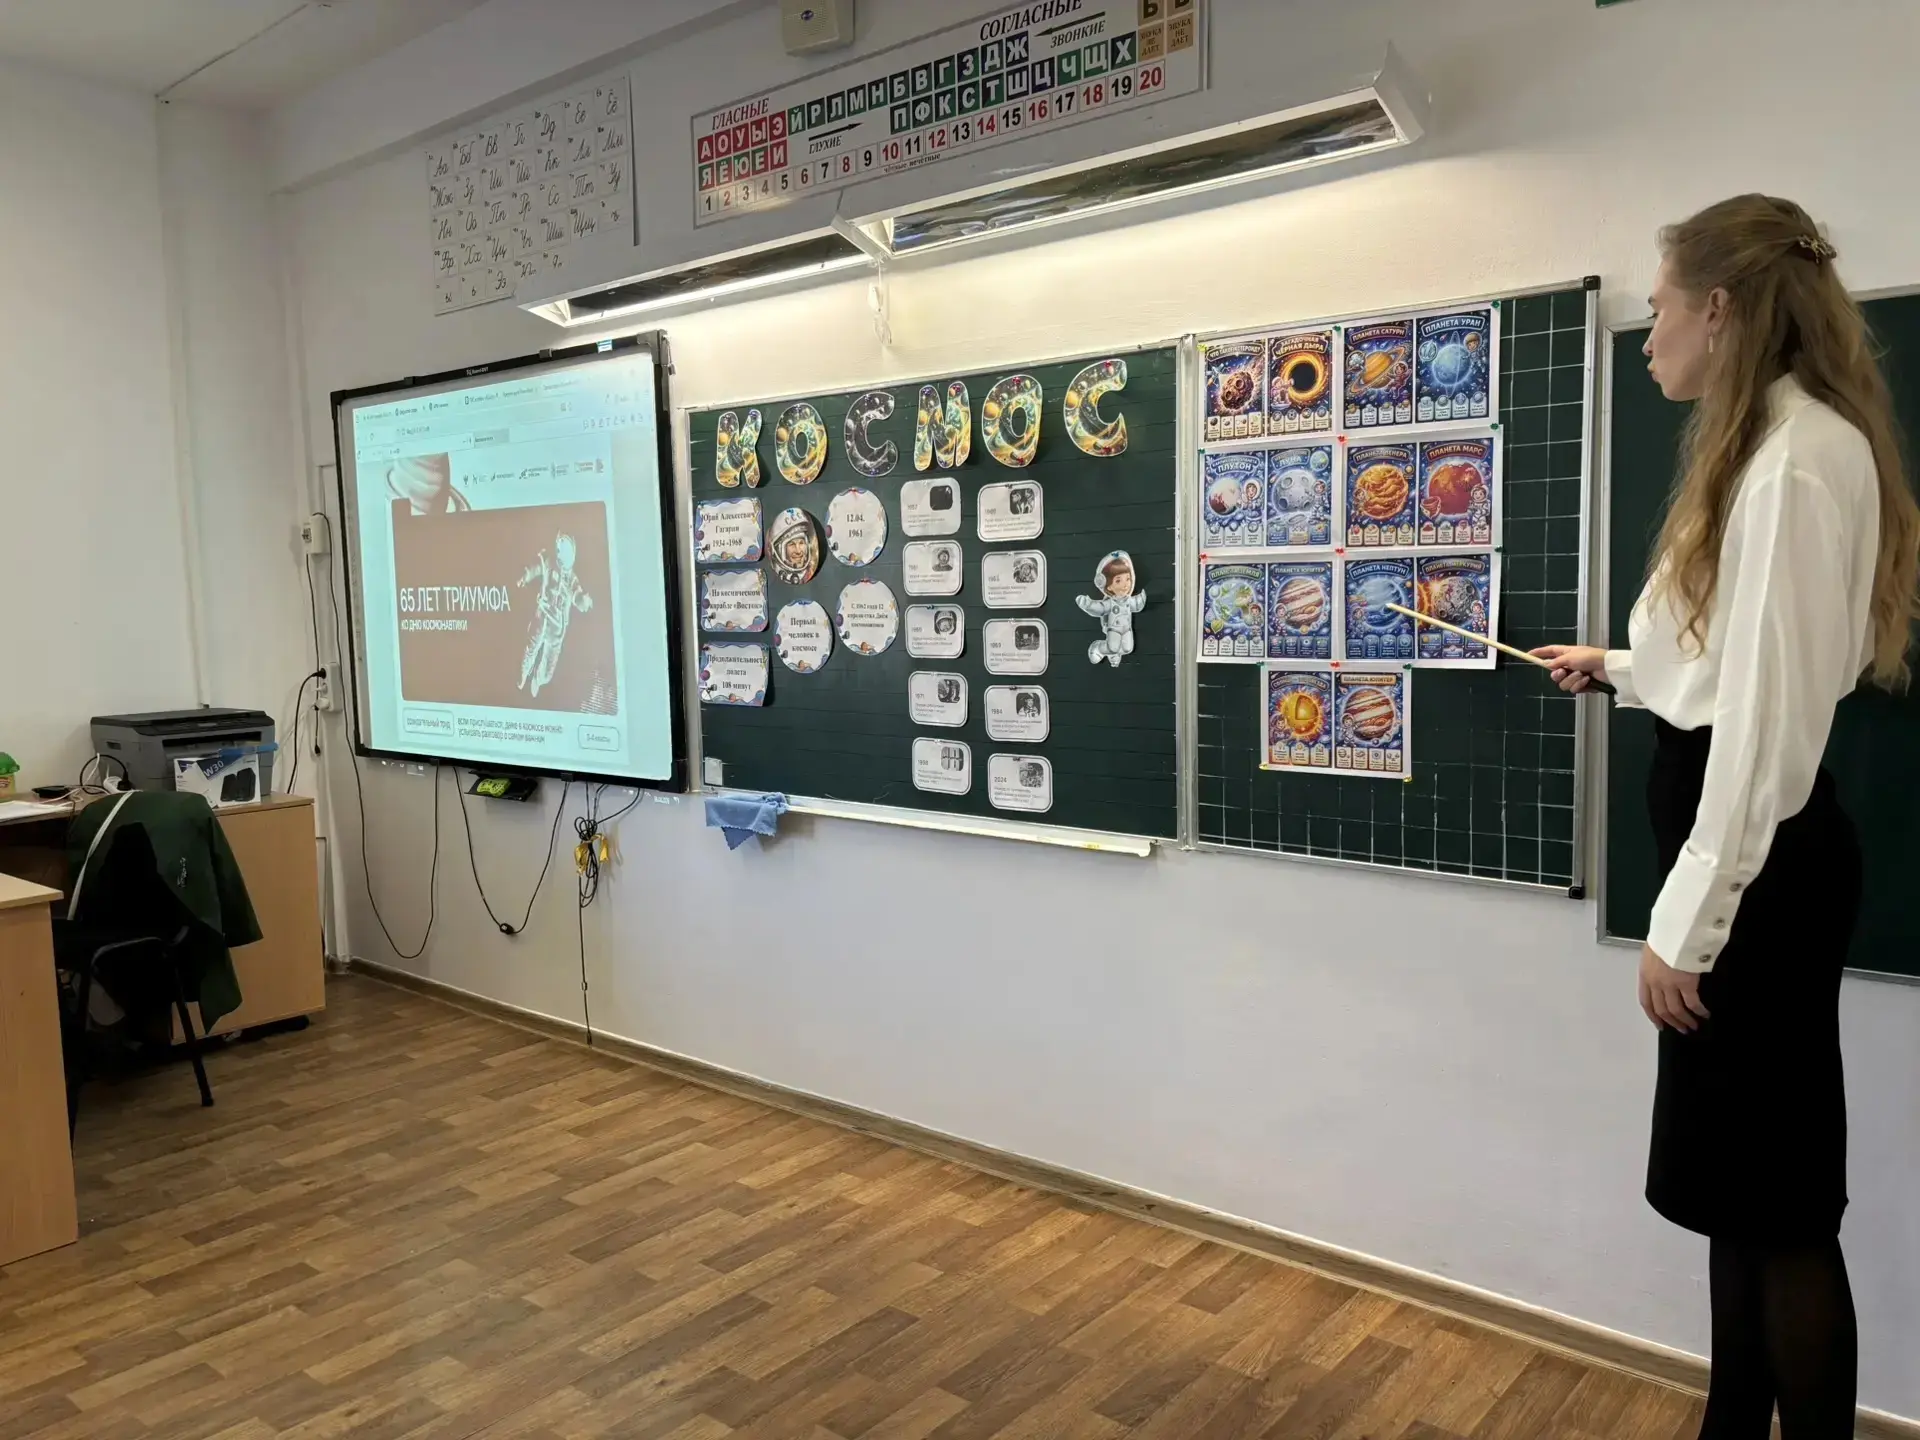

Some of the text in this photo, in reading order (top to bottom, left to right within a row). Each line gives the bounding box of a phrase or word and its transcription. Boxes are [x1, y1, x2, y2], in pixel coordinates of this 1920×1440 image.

[980, 0, 1081, 41] СОГЛАСНЫЕ
[1051, 20, 1105, 48] ЗВОНКИЕ
[701, 38, 1026, 159] А О У Ы Э Й Р Л М Н Б В Г З Д Ж
[702, 38, 1131, 185] Я Ё Ю Е И П Ф К С Т Ш Ц Ч Щ Х
[712, 98, 769, 130] ГЛАСНЫЕ
[485, 133, 498, 156] Вв
[705, 66, 1161, 211] 1 2 3 4 5 6 7 8 9 10 11 12 13 14 15 16 17 18 19 20
[809, 136, 842, 154] ГЛУХИЕ
[1425, 319, 1481, 333] ПЛАНЕТА УРАН
[1352, 328, 1405, 341] ПЛАНЕТА САТУРН
[1429, 445, 1483, 457] ПЛАНЕТА МАРС
[1218, 463, 1252, 472] ПЛУТОН
[846, 513, 865, 523] 12.04.
[716, 526, 739, 534] Гагарин
[848, 529, 863, 538] 1961
[1353, 565, 1406, 576] ПЛАНЕТА НЕПТУН
[400, 585, 511, 612] 65 ЛЕТ ТРИУМФА
[409, 620, 422, 632] ДНЮ
[790, 617, 817, 626] Первый
[788, 631, 814, 639] человек
[791, 644, 817, 653] космосе
[204, 760, 224, 777] W30
